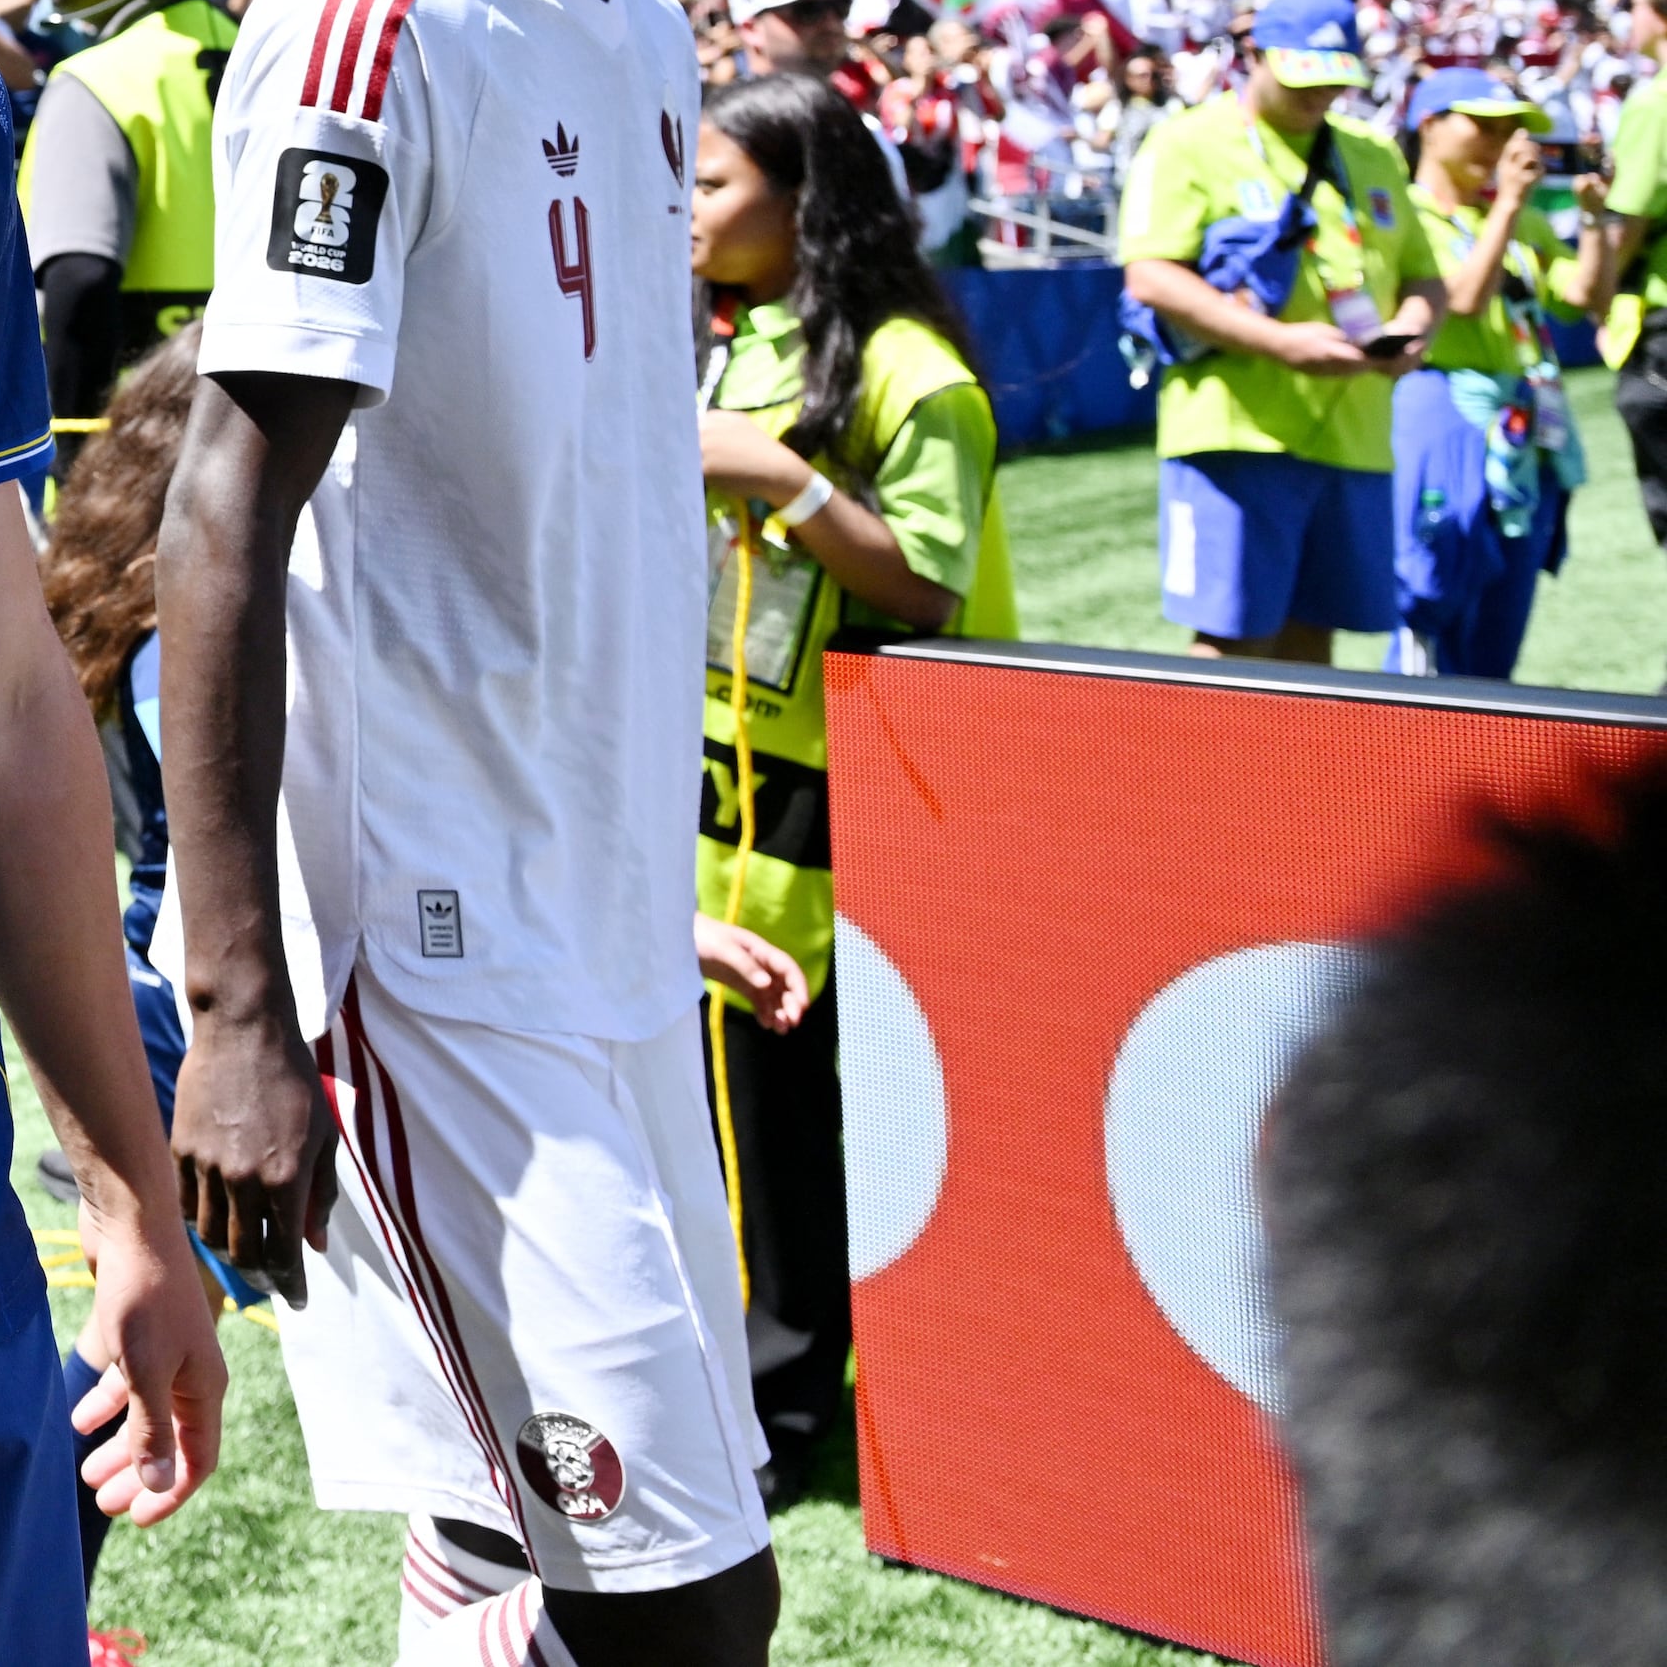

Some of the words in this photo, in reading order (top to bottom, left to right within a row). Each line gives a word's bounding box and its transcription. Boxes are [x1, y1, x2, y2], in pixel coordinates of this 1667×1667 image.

[310, 225, 335, 238] FIFA
[288, 250, 345, 272] 2026
[327, 248, 347, 259] CUP
[548, 196, 598, 363] 4
